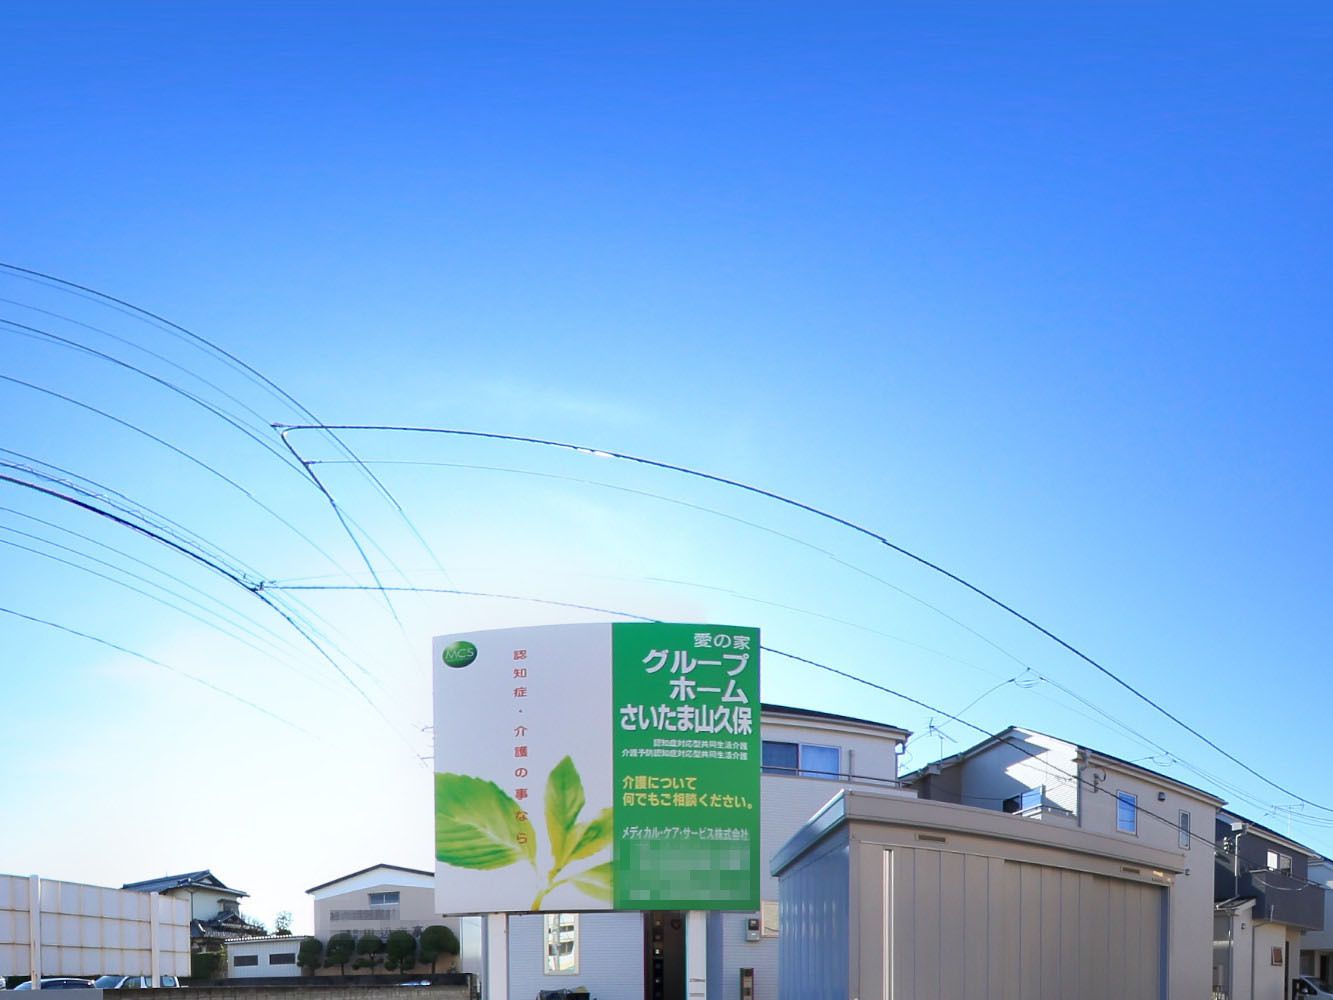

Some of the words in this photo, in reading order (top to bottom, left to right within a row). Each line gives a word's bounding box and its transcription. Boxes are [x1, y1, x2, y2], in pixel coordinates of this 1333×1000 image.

[693, 632, 751, 650] 愛の家
[445, 647, 474, 660] MCS
[642, 649, 750, 676] グループ
[669, 676, 749, 704] ホーム
[619, 703, 753, 735] さいたま山久保
[622, 775, 698, 790] 介護について
[622, 792, 753, 810] 何でもご相談ください。
